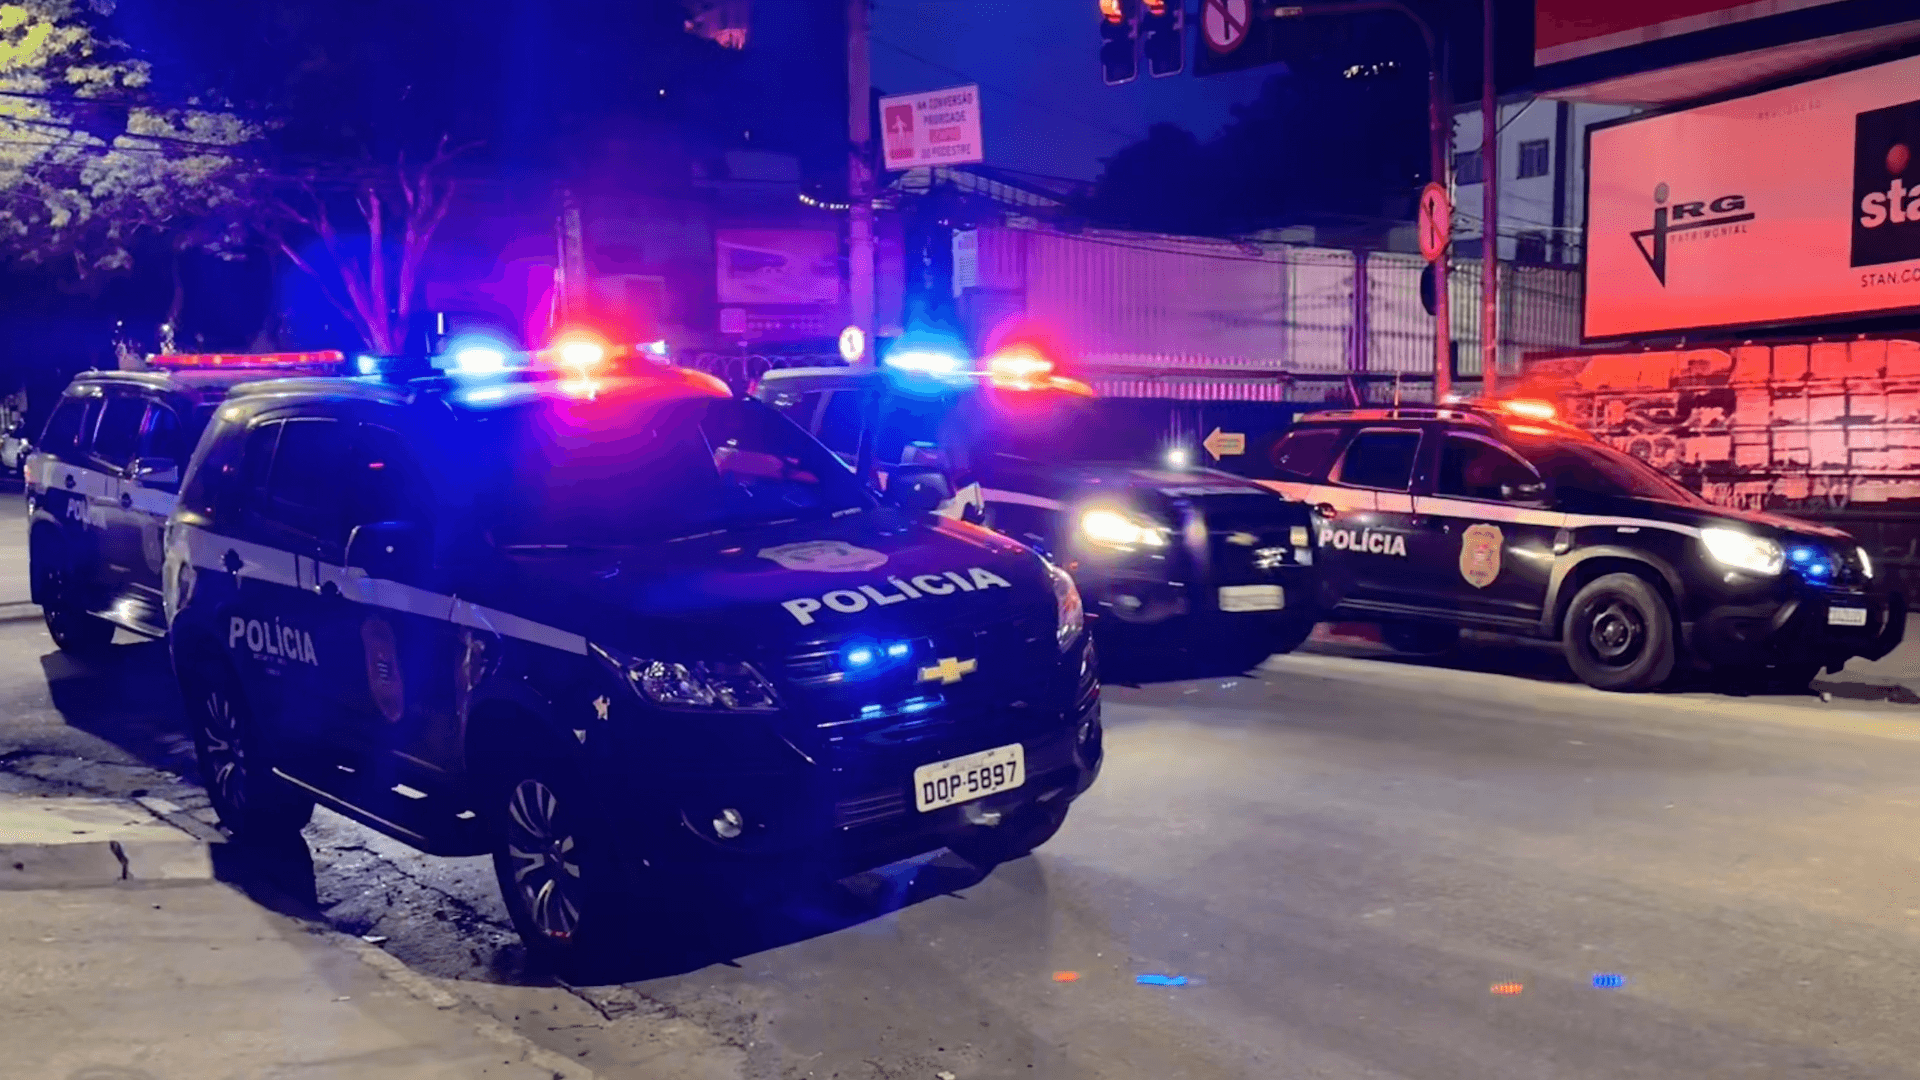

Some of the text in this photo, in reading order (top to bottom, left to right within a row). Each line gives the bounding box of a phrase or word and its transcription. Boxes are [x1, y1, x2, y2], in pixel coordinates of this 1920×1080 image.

[1318, 527, 1407, 556] POLÍCIA
[781, 567, 1012, 626] POLÍCIA
[228, 615, 319, 667] POLÍCIA
